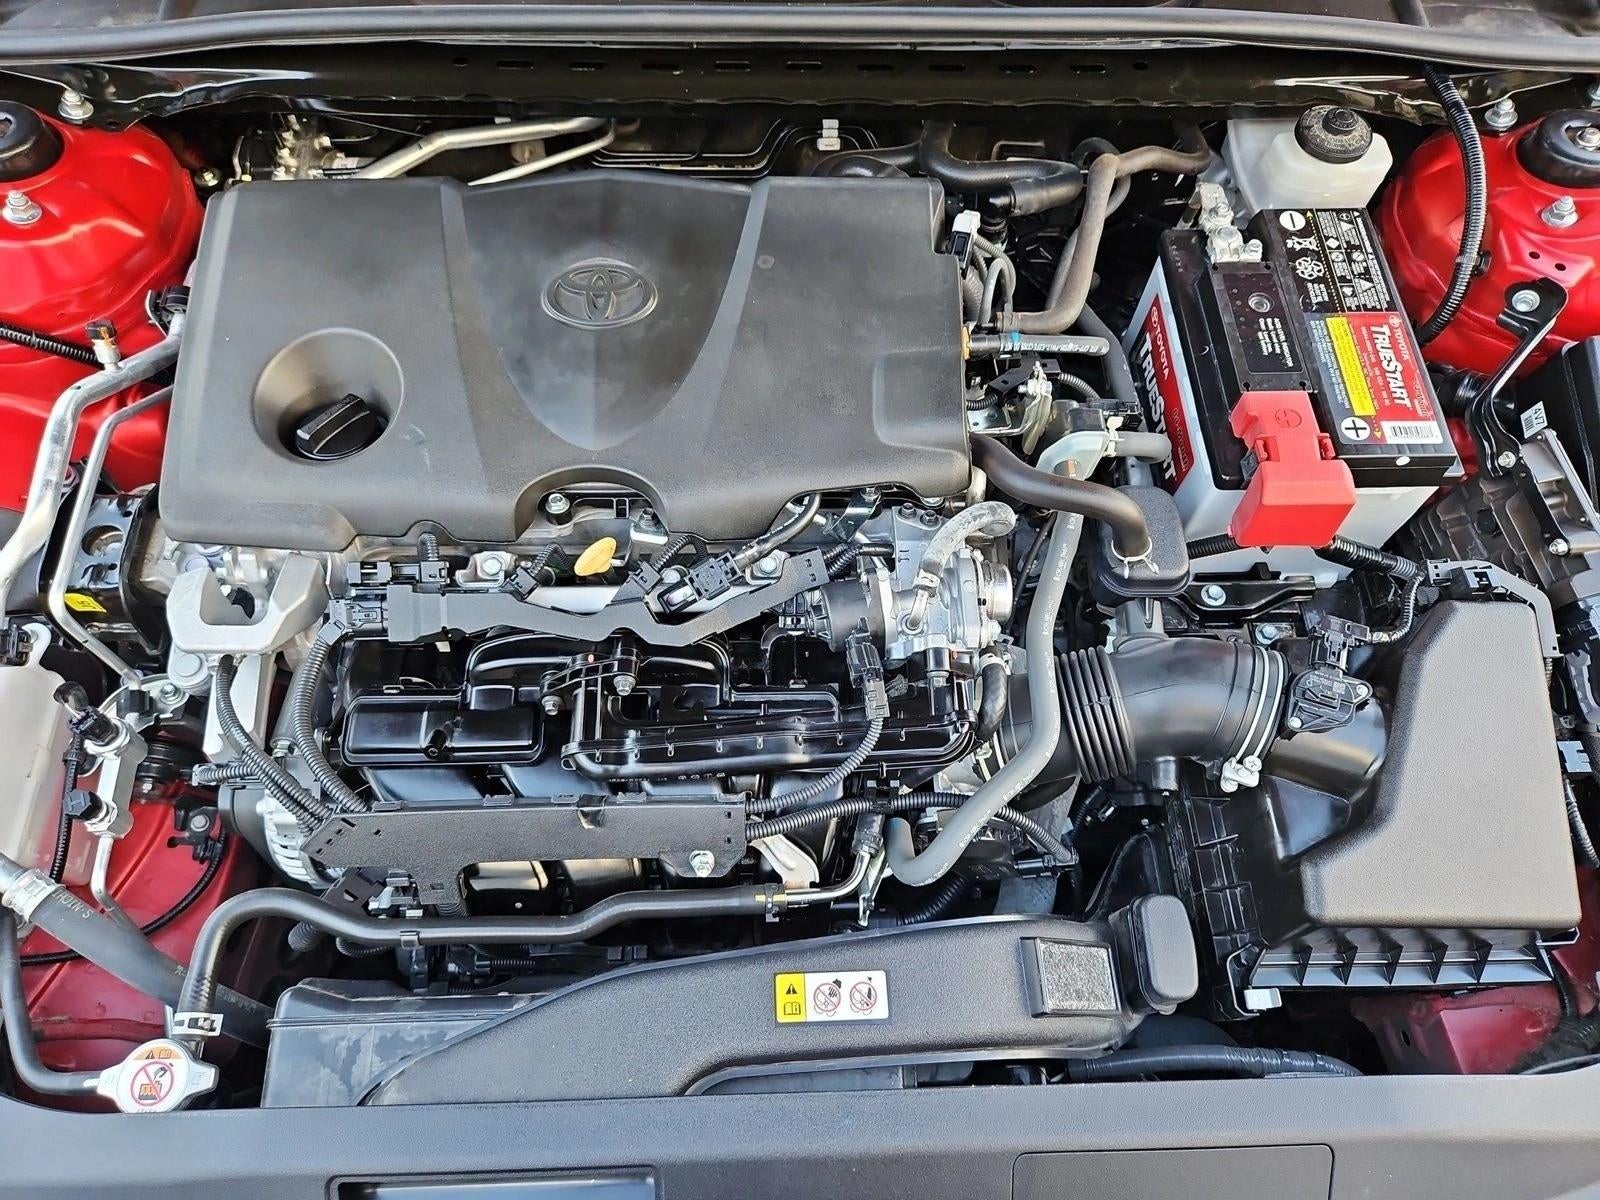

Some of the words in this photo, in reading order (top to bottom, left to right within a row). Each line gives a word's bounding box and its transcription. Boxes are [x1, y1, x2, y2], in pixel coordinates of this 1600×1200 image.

[1155, 325, 1170, 380] TOYOTA
[1281, 342, 1294, 368] INDICATOR
[1393, 329, 1411, 361] TOYOTA
[1138, 331, 1177, 480] TRUESTRT
